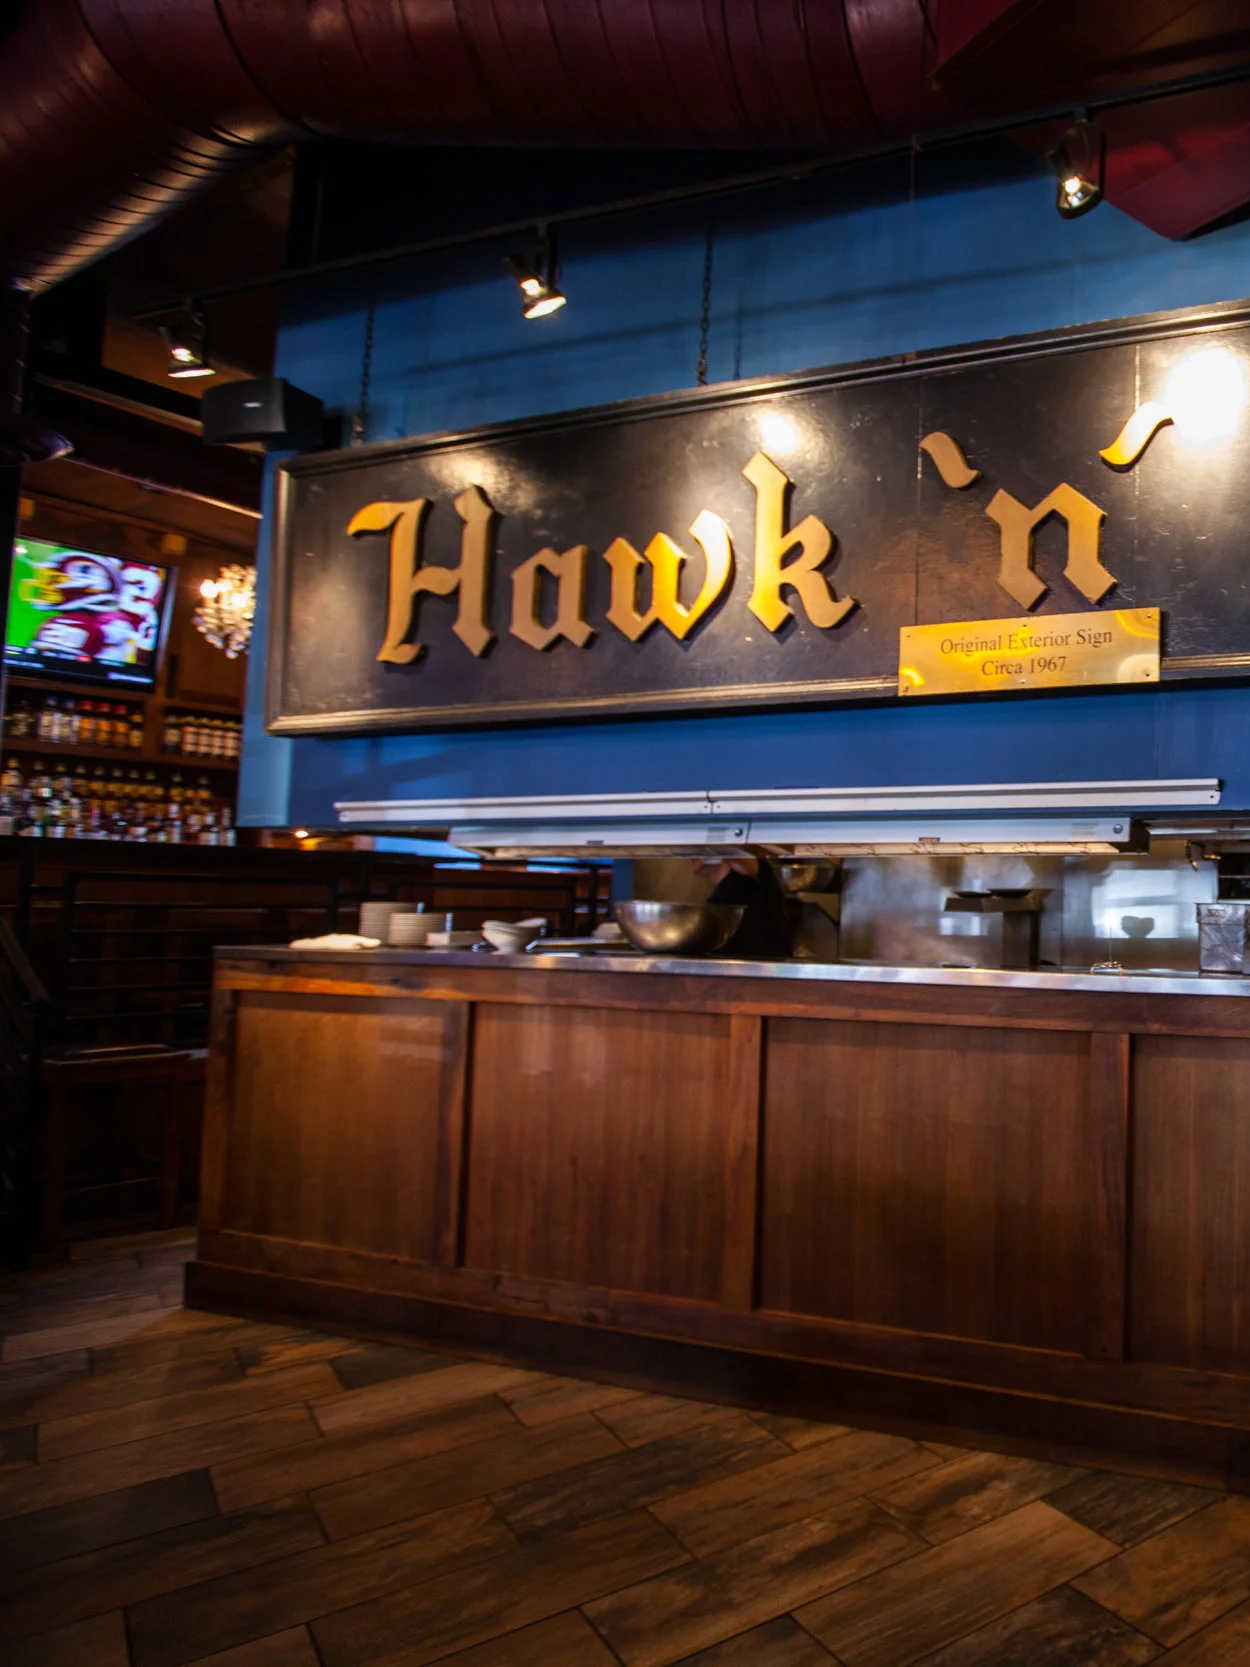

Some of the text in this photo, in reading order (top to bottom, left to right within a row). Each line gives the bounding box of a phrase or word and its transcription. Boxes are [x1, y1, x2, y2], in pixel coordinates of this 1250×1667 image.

[347, 451, 854, 664] Hawk
[940, 628, 1113, 656] Original Exterior Sign
[981, 656, 1067, 676] Circa 1967
